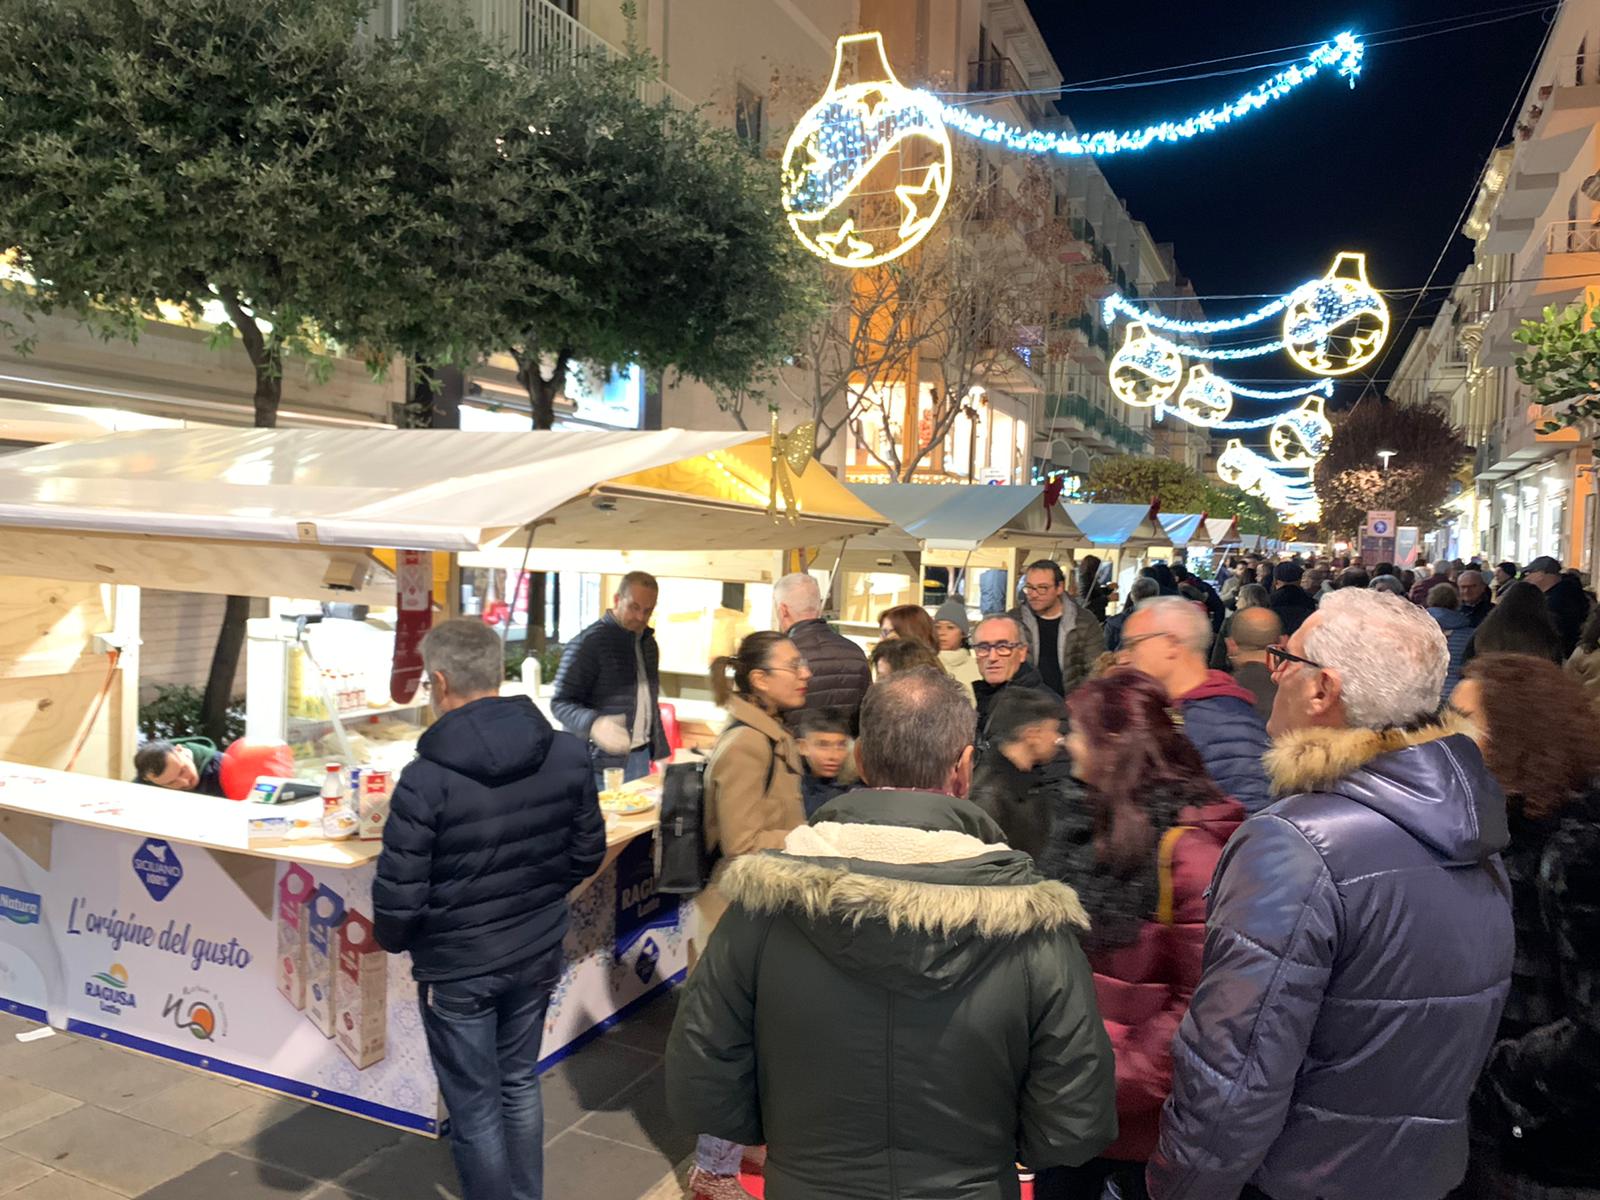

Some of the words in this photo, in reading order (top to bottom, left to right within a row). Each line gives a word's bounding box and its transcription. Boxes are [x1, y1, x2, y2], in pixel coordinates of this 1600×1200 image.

[66, 897, 155, 951] L'origine
[158, 919, 192, 956] del
[191, 937, 253, 971] gusto
[85, 981, 137, 1008] RAGUSA
